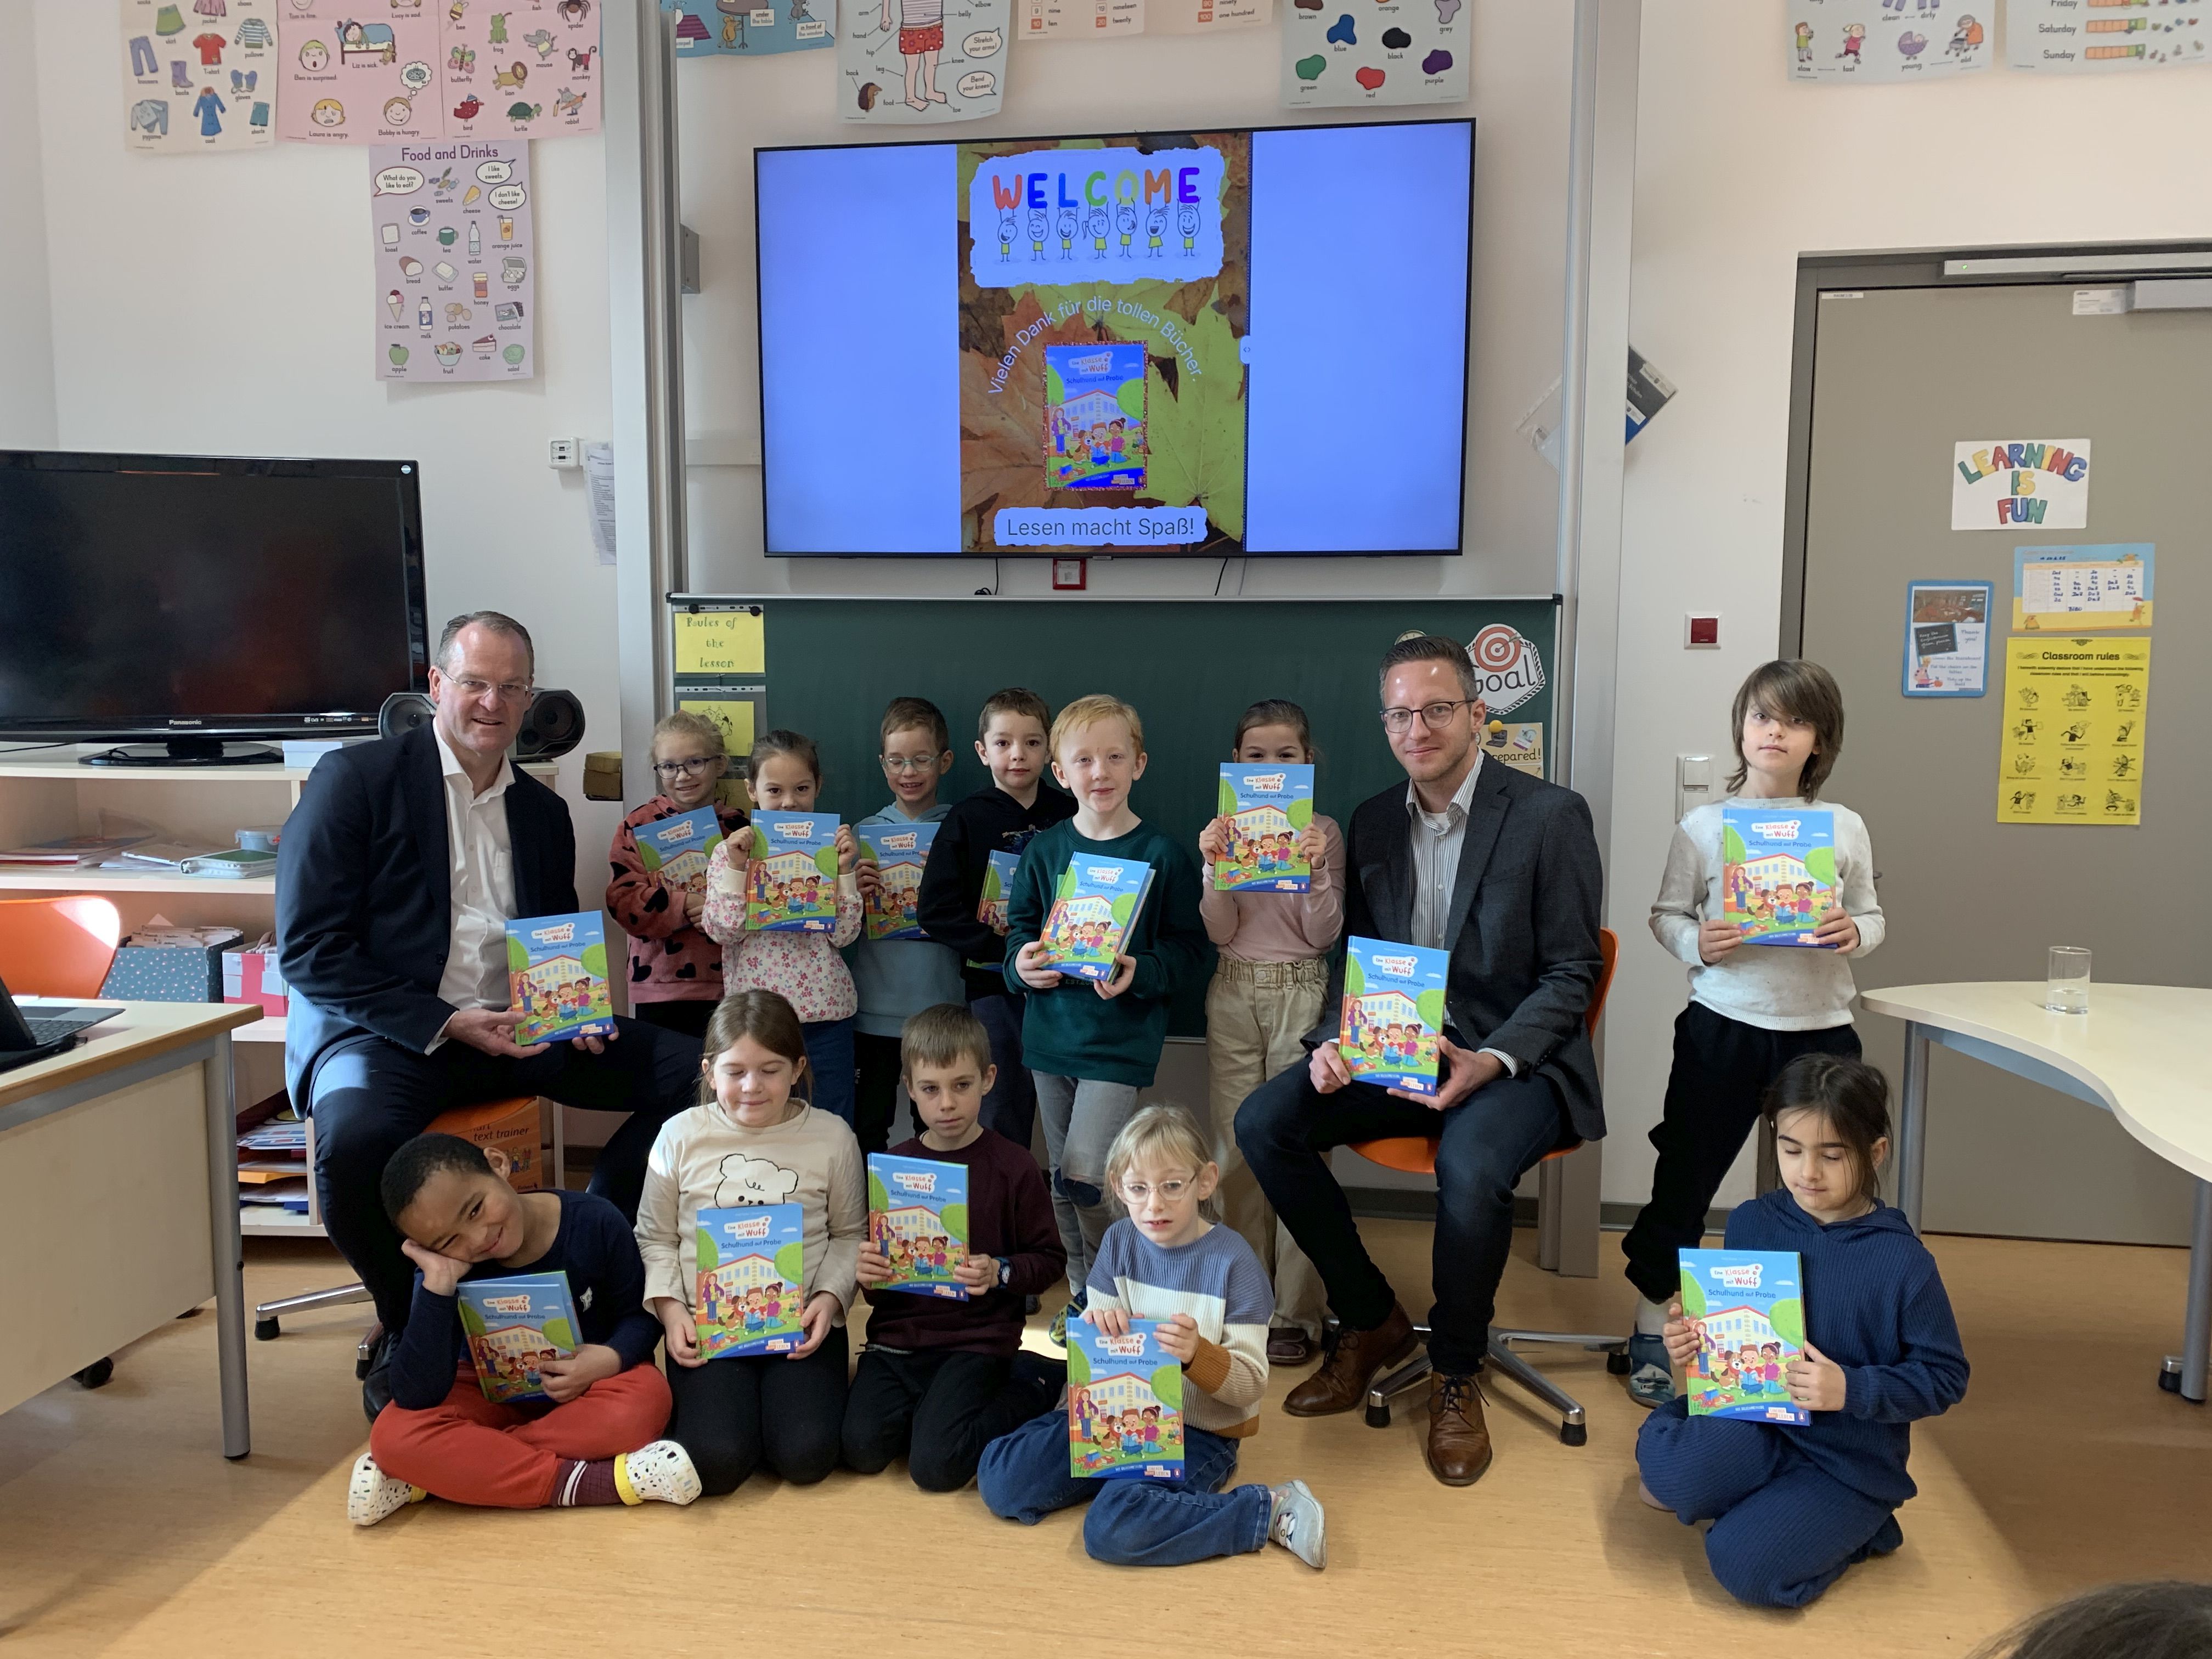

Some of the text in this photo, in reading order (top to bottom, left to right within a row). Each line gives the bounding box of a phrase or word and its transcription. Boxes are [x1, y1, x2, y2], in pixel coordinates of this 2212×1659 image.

[1231, 9, 1255, 17] hundred
[2039, 24, 2076, 35] Saturday
[969, 45, 980, 53] your
[2044, 50, 2075, 60] Sunday
[402, 144, 498, 161] Food and Drinks
[992, 167, 1200, 210] WELCOME
[988, 296, 1201, 396] Vielen Dank für die tollen Bücher.
[1089, 363, 1109, 373] Wuff
[1066, 375, 1096, 384] Schulhund
[1958, 443, 2087, 484] LEARNING
[2011, 470, 2035, 495] IS
[1997, 497, 2047, 524] FUN
[1008, 518, 1194, 539] Lesen macht Spaß!
[687, 617, 737, 629] Rules of
[706, 639, 724, 647] the
[2042, 651, 2119, 661] Classroom rules
[700, 657, 734, 668] lesson
[1492, 748, 1541, 764] repared!
[668, 826, 685, 835] Klasse
[675, 830, 691, 839] Wuff
[659, 841, 685, 852] Schulhund
[1392, 966, 1411, 975] Wuff
[1368, 974, 1398, 983] Schulhund
[474, 1127, 529, 1141] text trainer
[913, 1183, 931, 1192] Wuff
[891, 1190, 946, 1203] Schulhund Probe
[746, 1228, 766, 1237] Wuff
[1735, 1278, 1757, 1286] Wuff
[1119, 1346, 1141, 1355] Wuff
